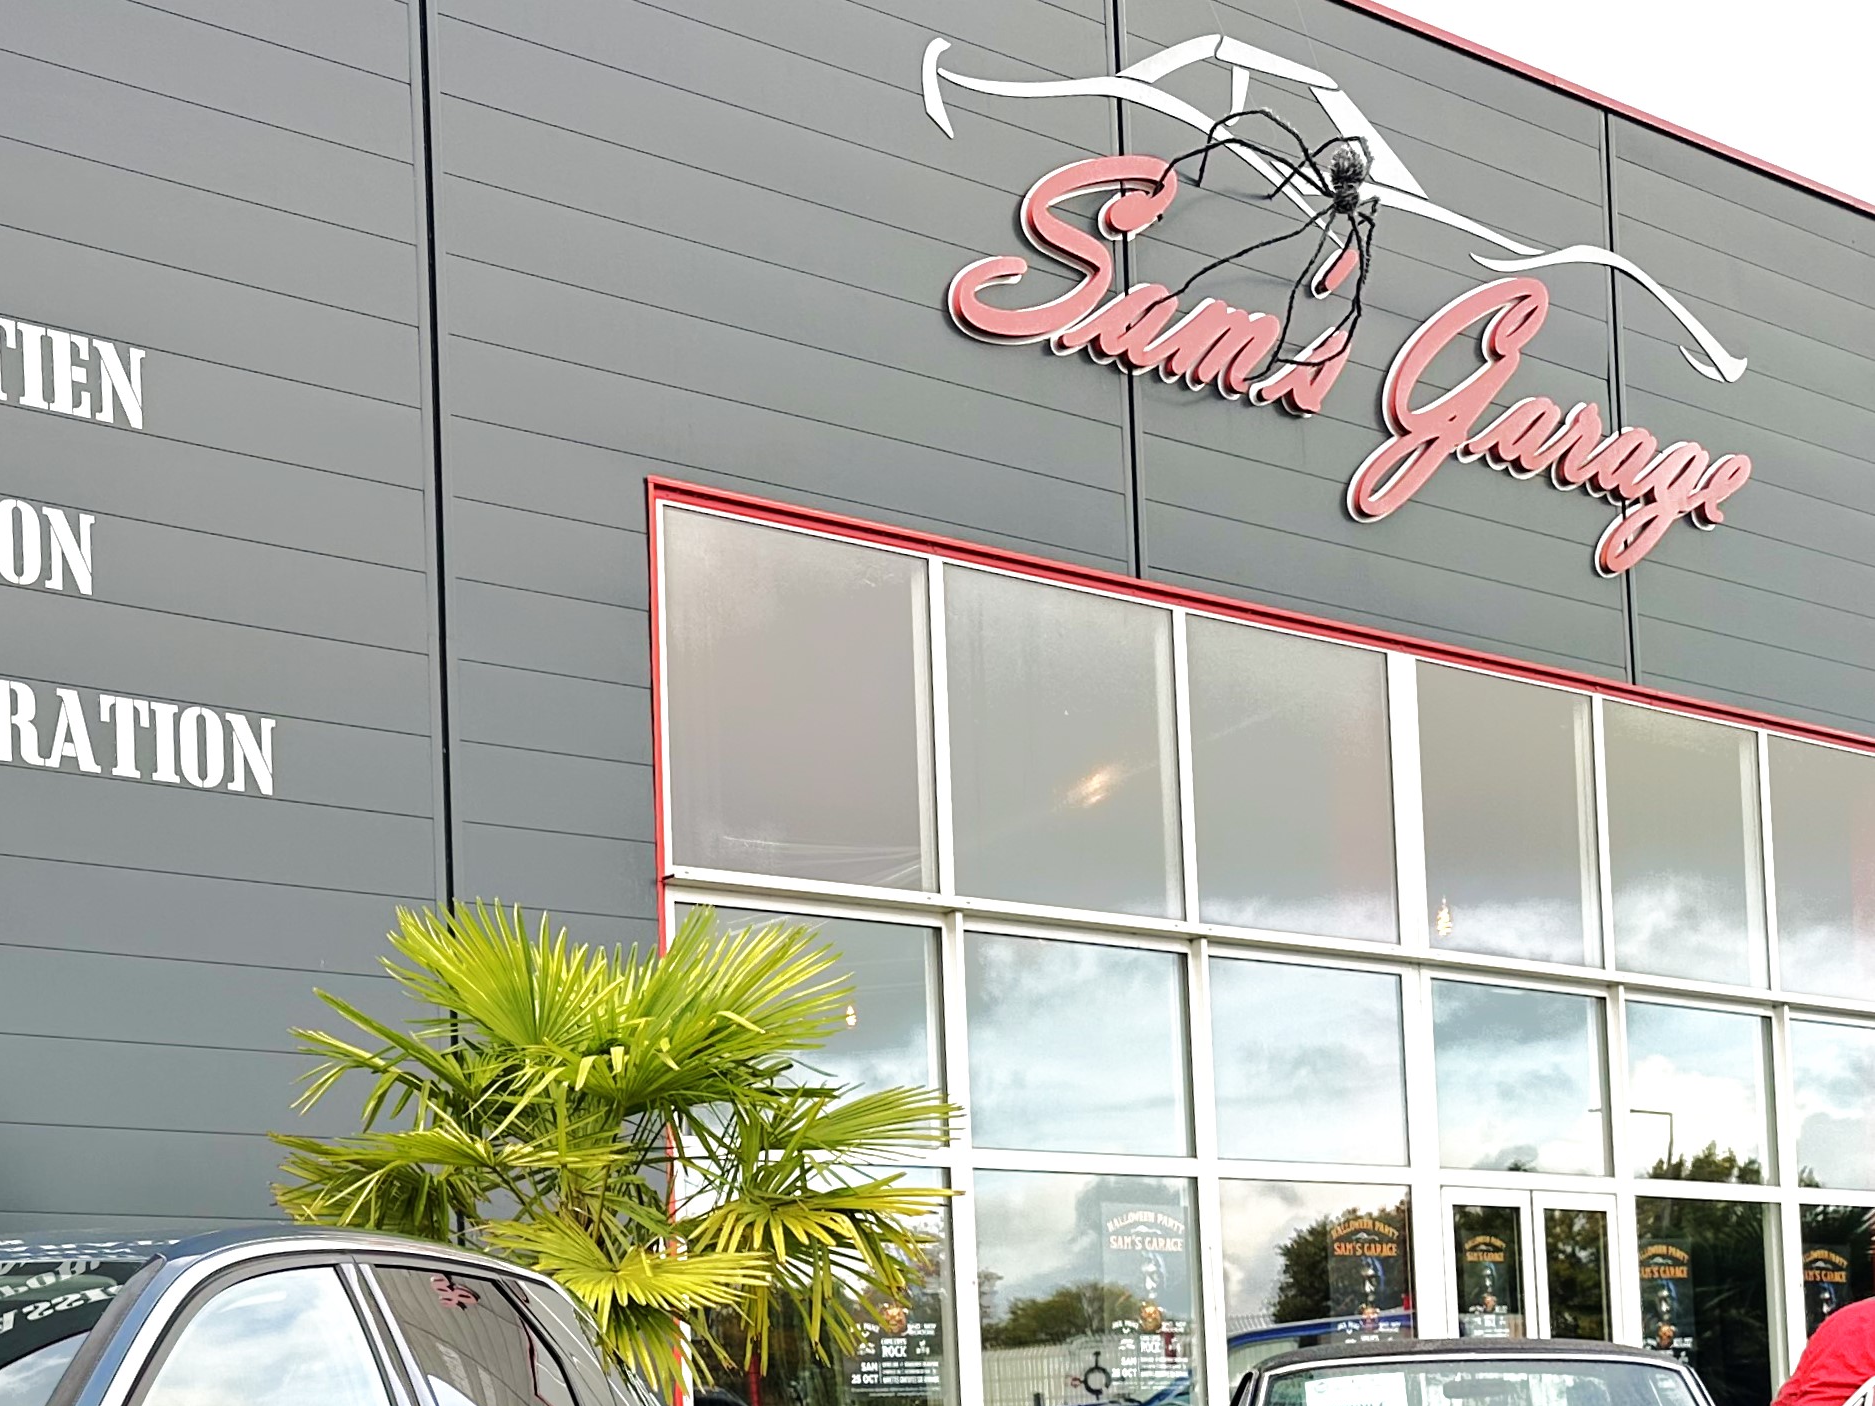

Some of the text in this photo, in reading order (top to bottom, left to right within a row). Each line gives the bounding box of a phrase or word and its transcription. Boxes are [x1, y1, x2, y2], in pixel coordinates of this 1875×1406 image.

[948, 155, 1752, 578] Sam's Garage
[1107, 1210, 1185, 1235] HALLOWEEN PARTY
[1375, 1220, 1399, 1240] PARTY
[1109, 1235, 1184, 1252] SAM'S GARAGE
[1334, 1242, 1398, 1257] SAM'S GARAGE
[881, 1345, 907, 1358] ROCK
[860, 1361, 879, 1373] SAM
[862, 1373, 879, 1385] OCT
